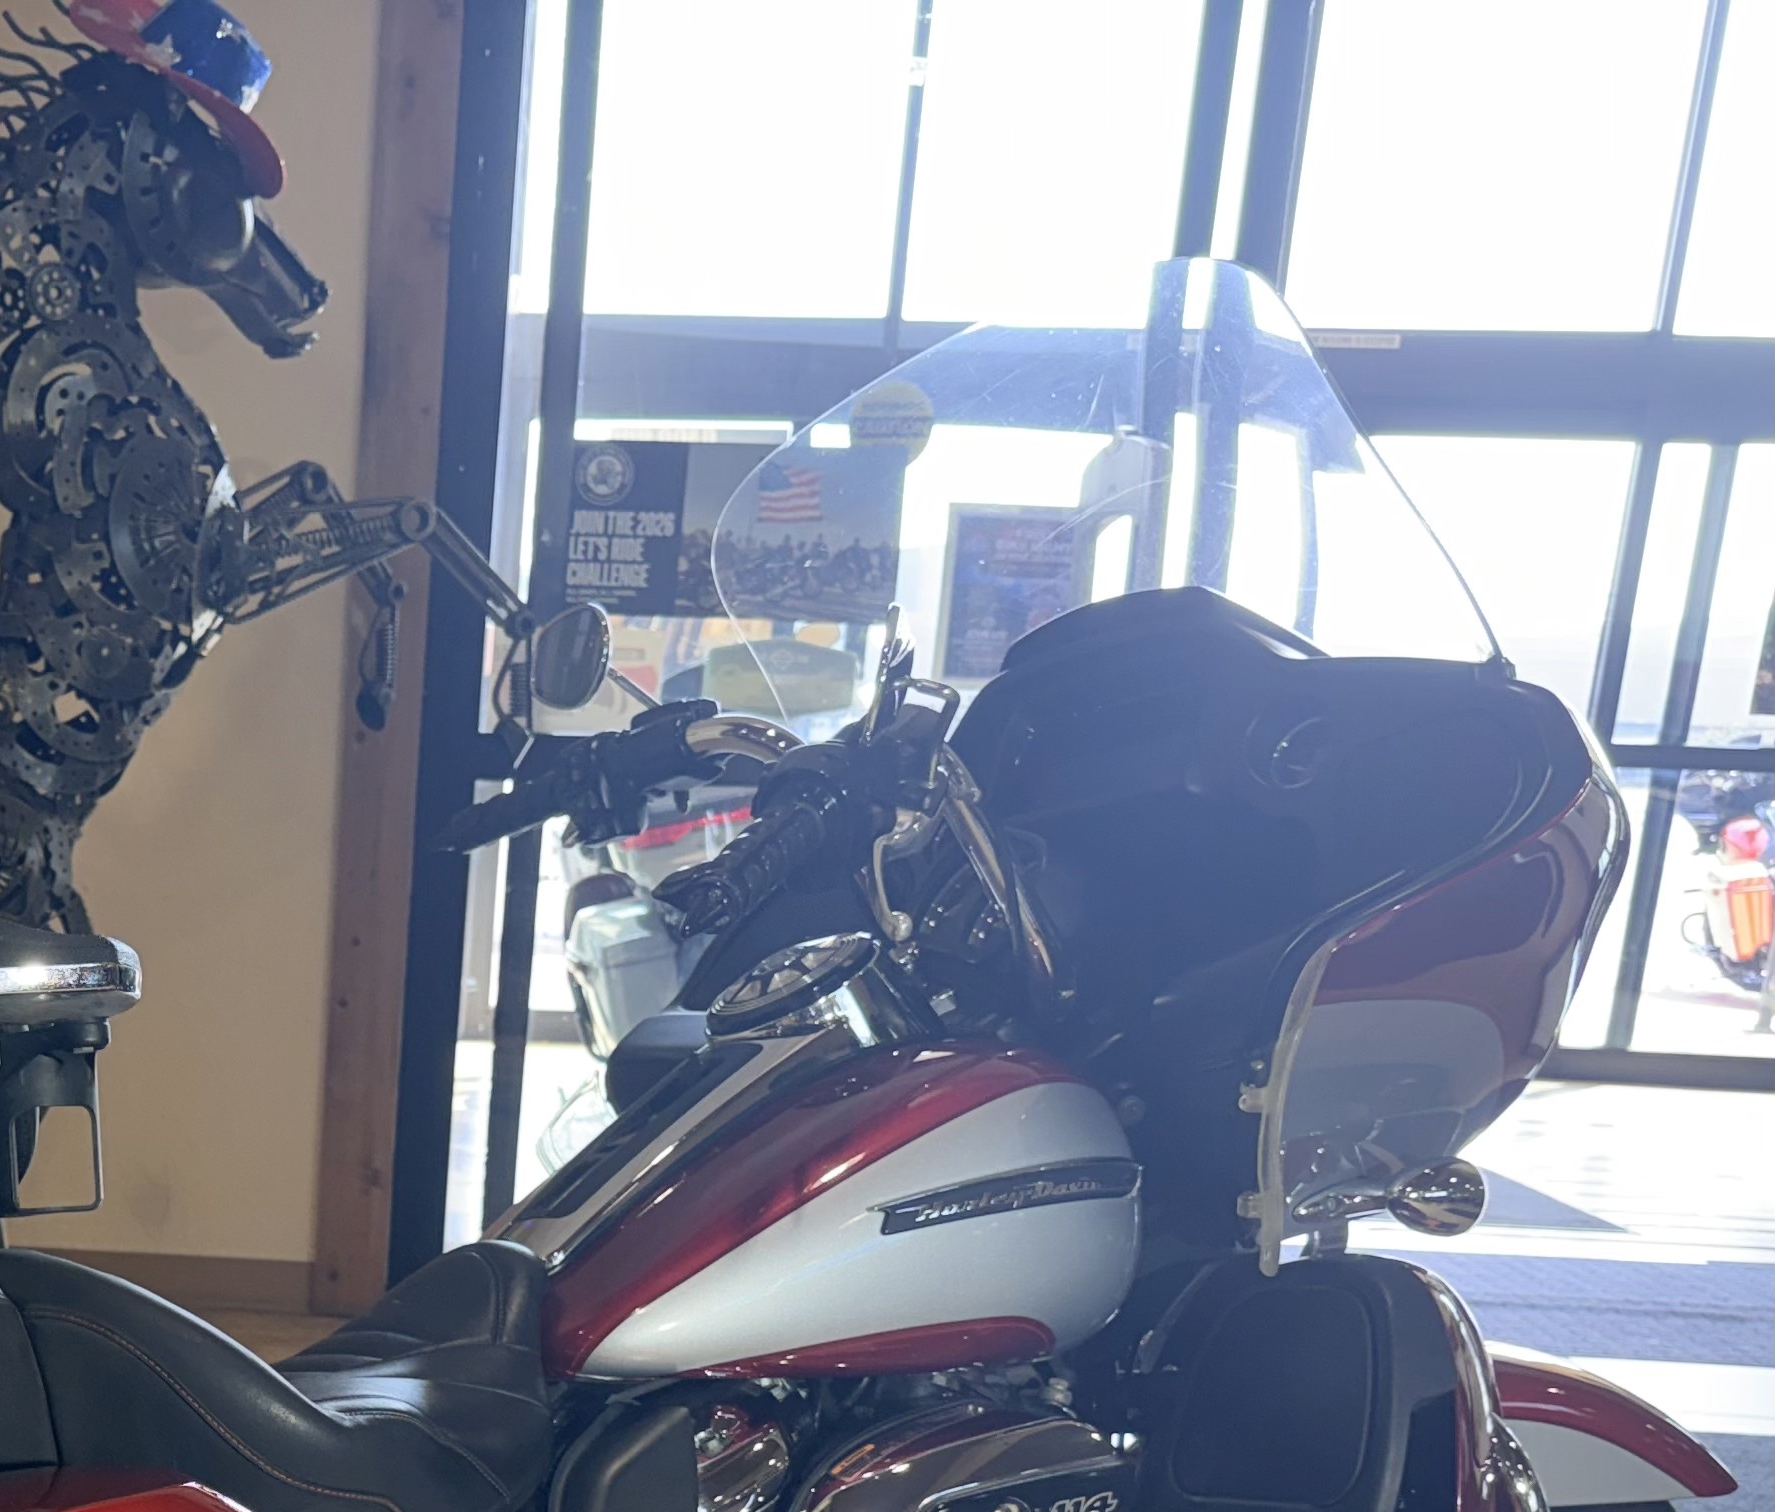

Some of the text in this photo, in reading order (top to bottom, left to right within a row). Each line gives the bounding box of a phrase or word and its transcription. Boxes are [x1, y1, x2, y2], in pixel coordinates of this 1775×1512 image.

[607, 511, 636, 536] THE
[568, 535, 609, 560] LET'S
[565, 561, 650, 588] CHALLENGE
